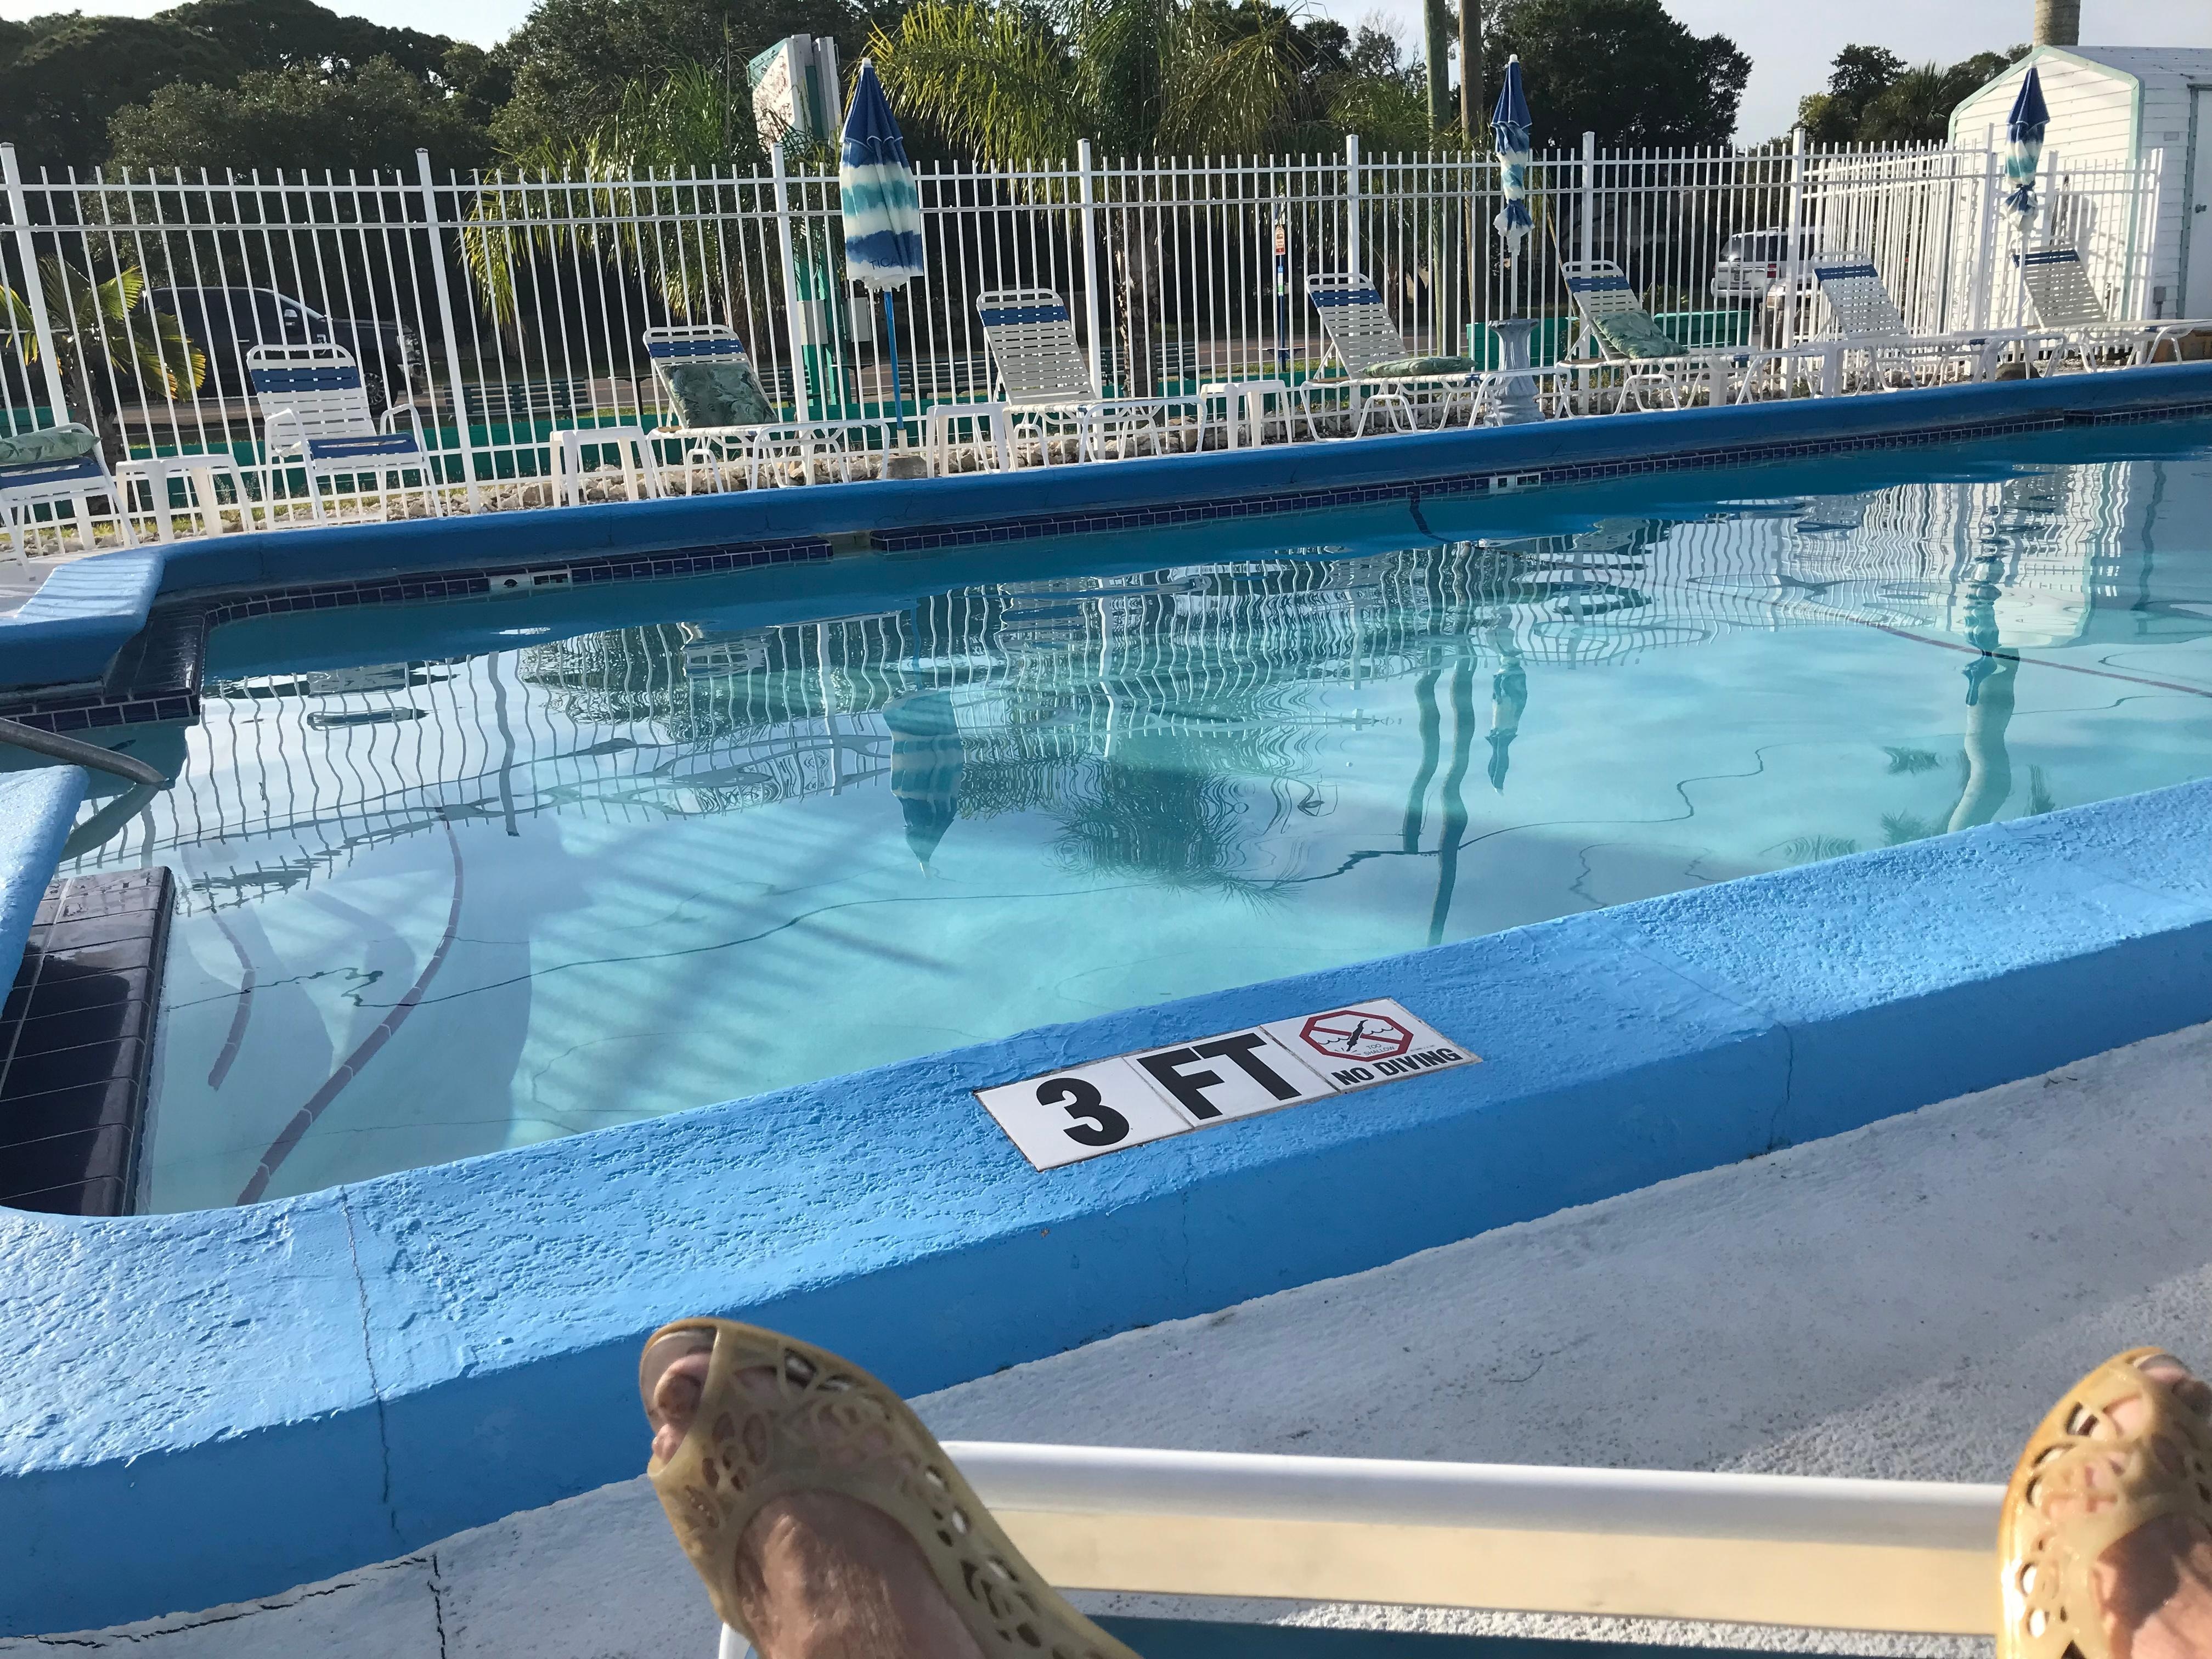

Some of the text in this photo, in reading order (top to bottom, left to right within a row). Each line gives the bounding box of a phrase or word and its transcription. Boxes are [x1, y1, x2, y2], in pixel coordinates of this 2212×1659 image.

[1331, 1048, 1463, 1086] NO DIVING
[1363, 1046, 1395, 1056] SHALLOW
[1036, 1032, 1302, 1147] 3 FT
